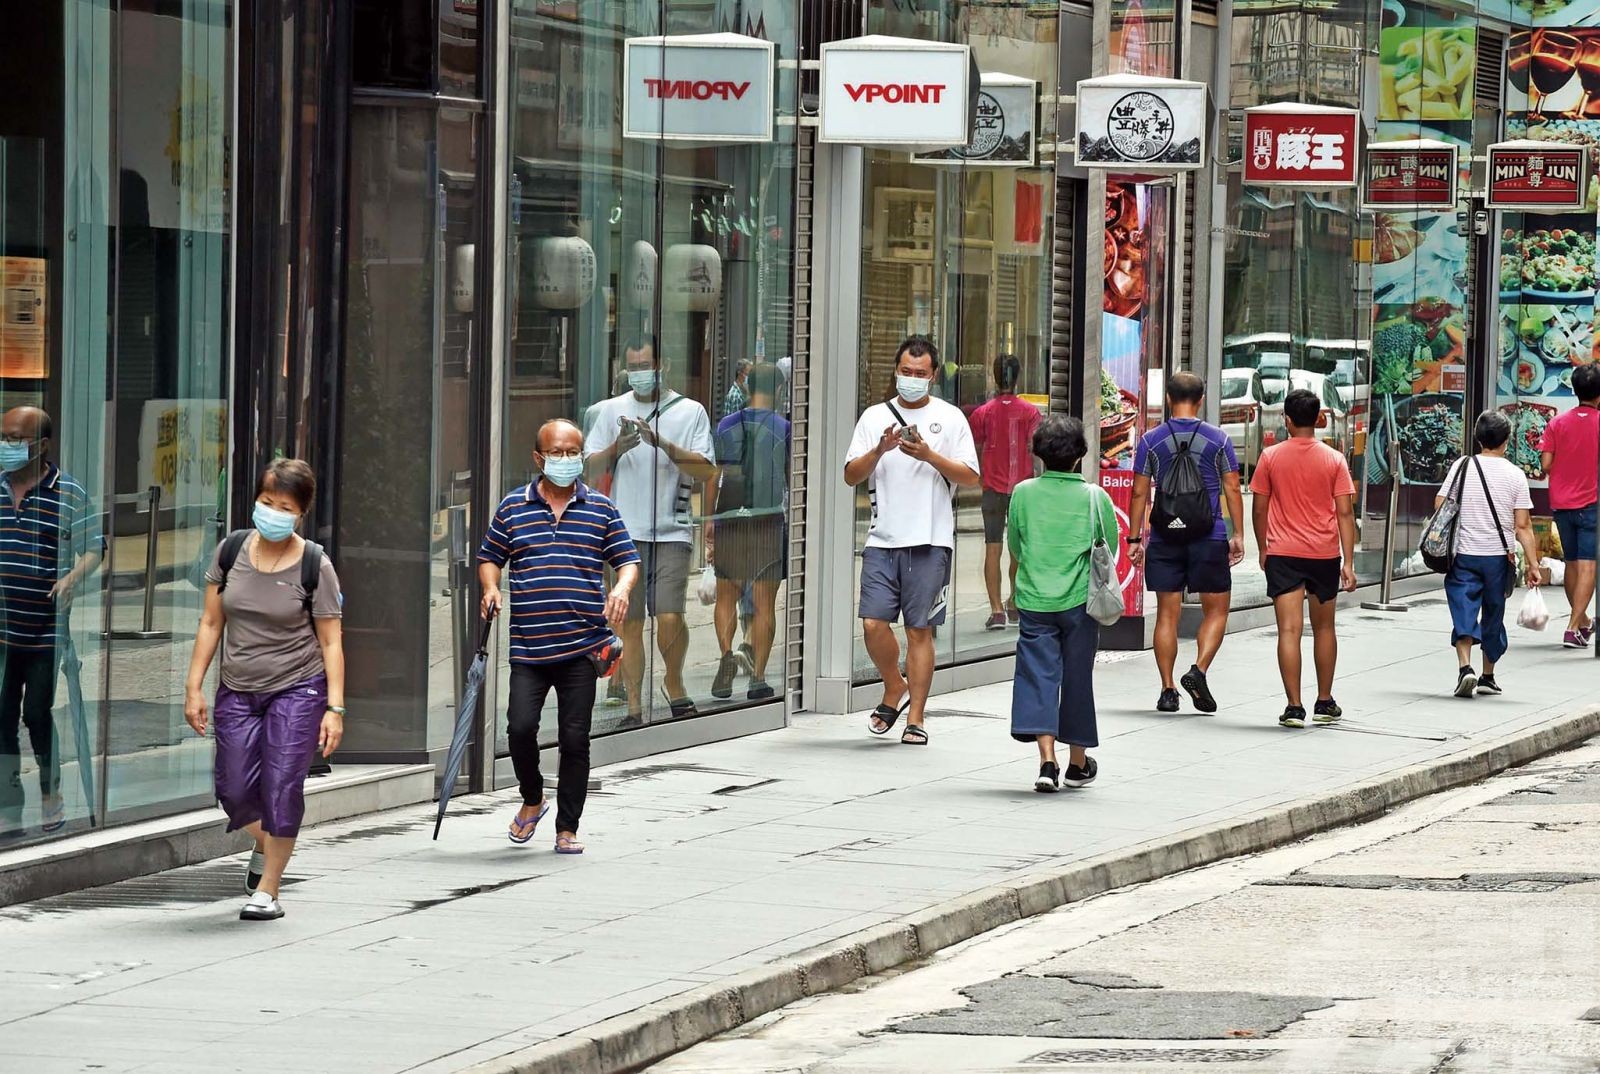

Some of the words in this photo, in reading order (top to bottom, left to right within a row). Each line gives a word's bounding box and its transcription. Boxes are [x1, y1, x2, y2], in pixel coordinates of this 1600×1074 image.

[843, 83, 946, 104] VPOINT
[1276, 133, 1345, 171] 豚王
[1495, 165, 1525, 182] MIN
[1546, 165, 1577, 182] JUN
